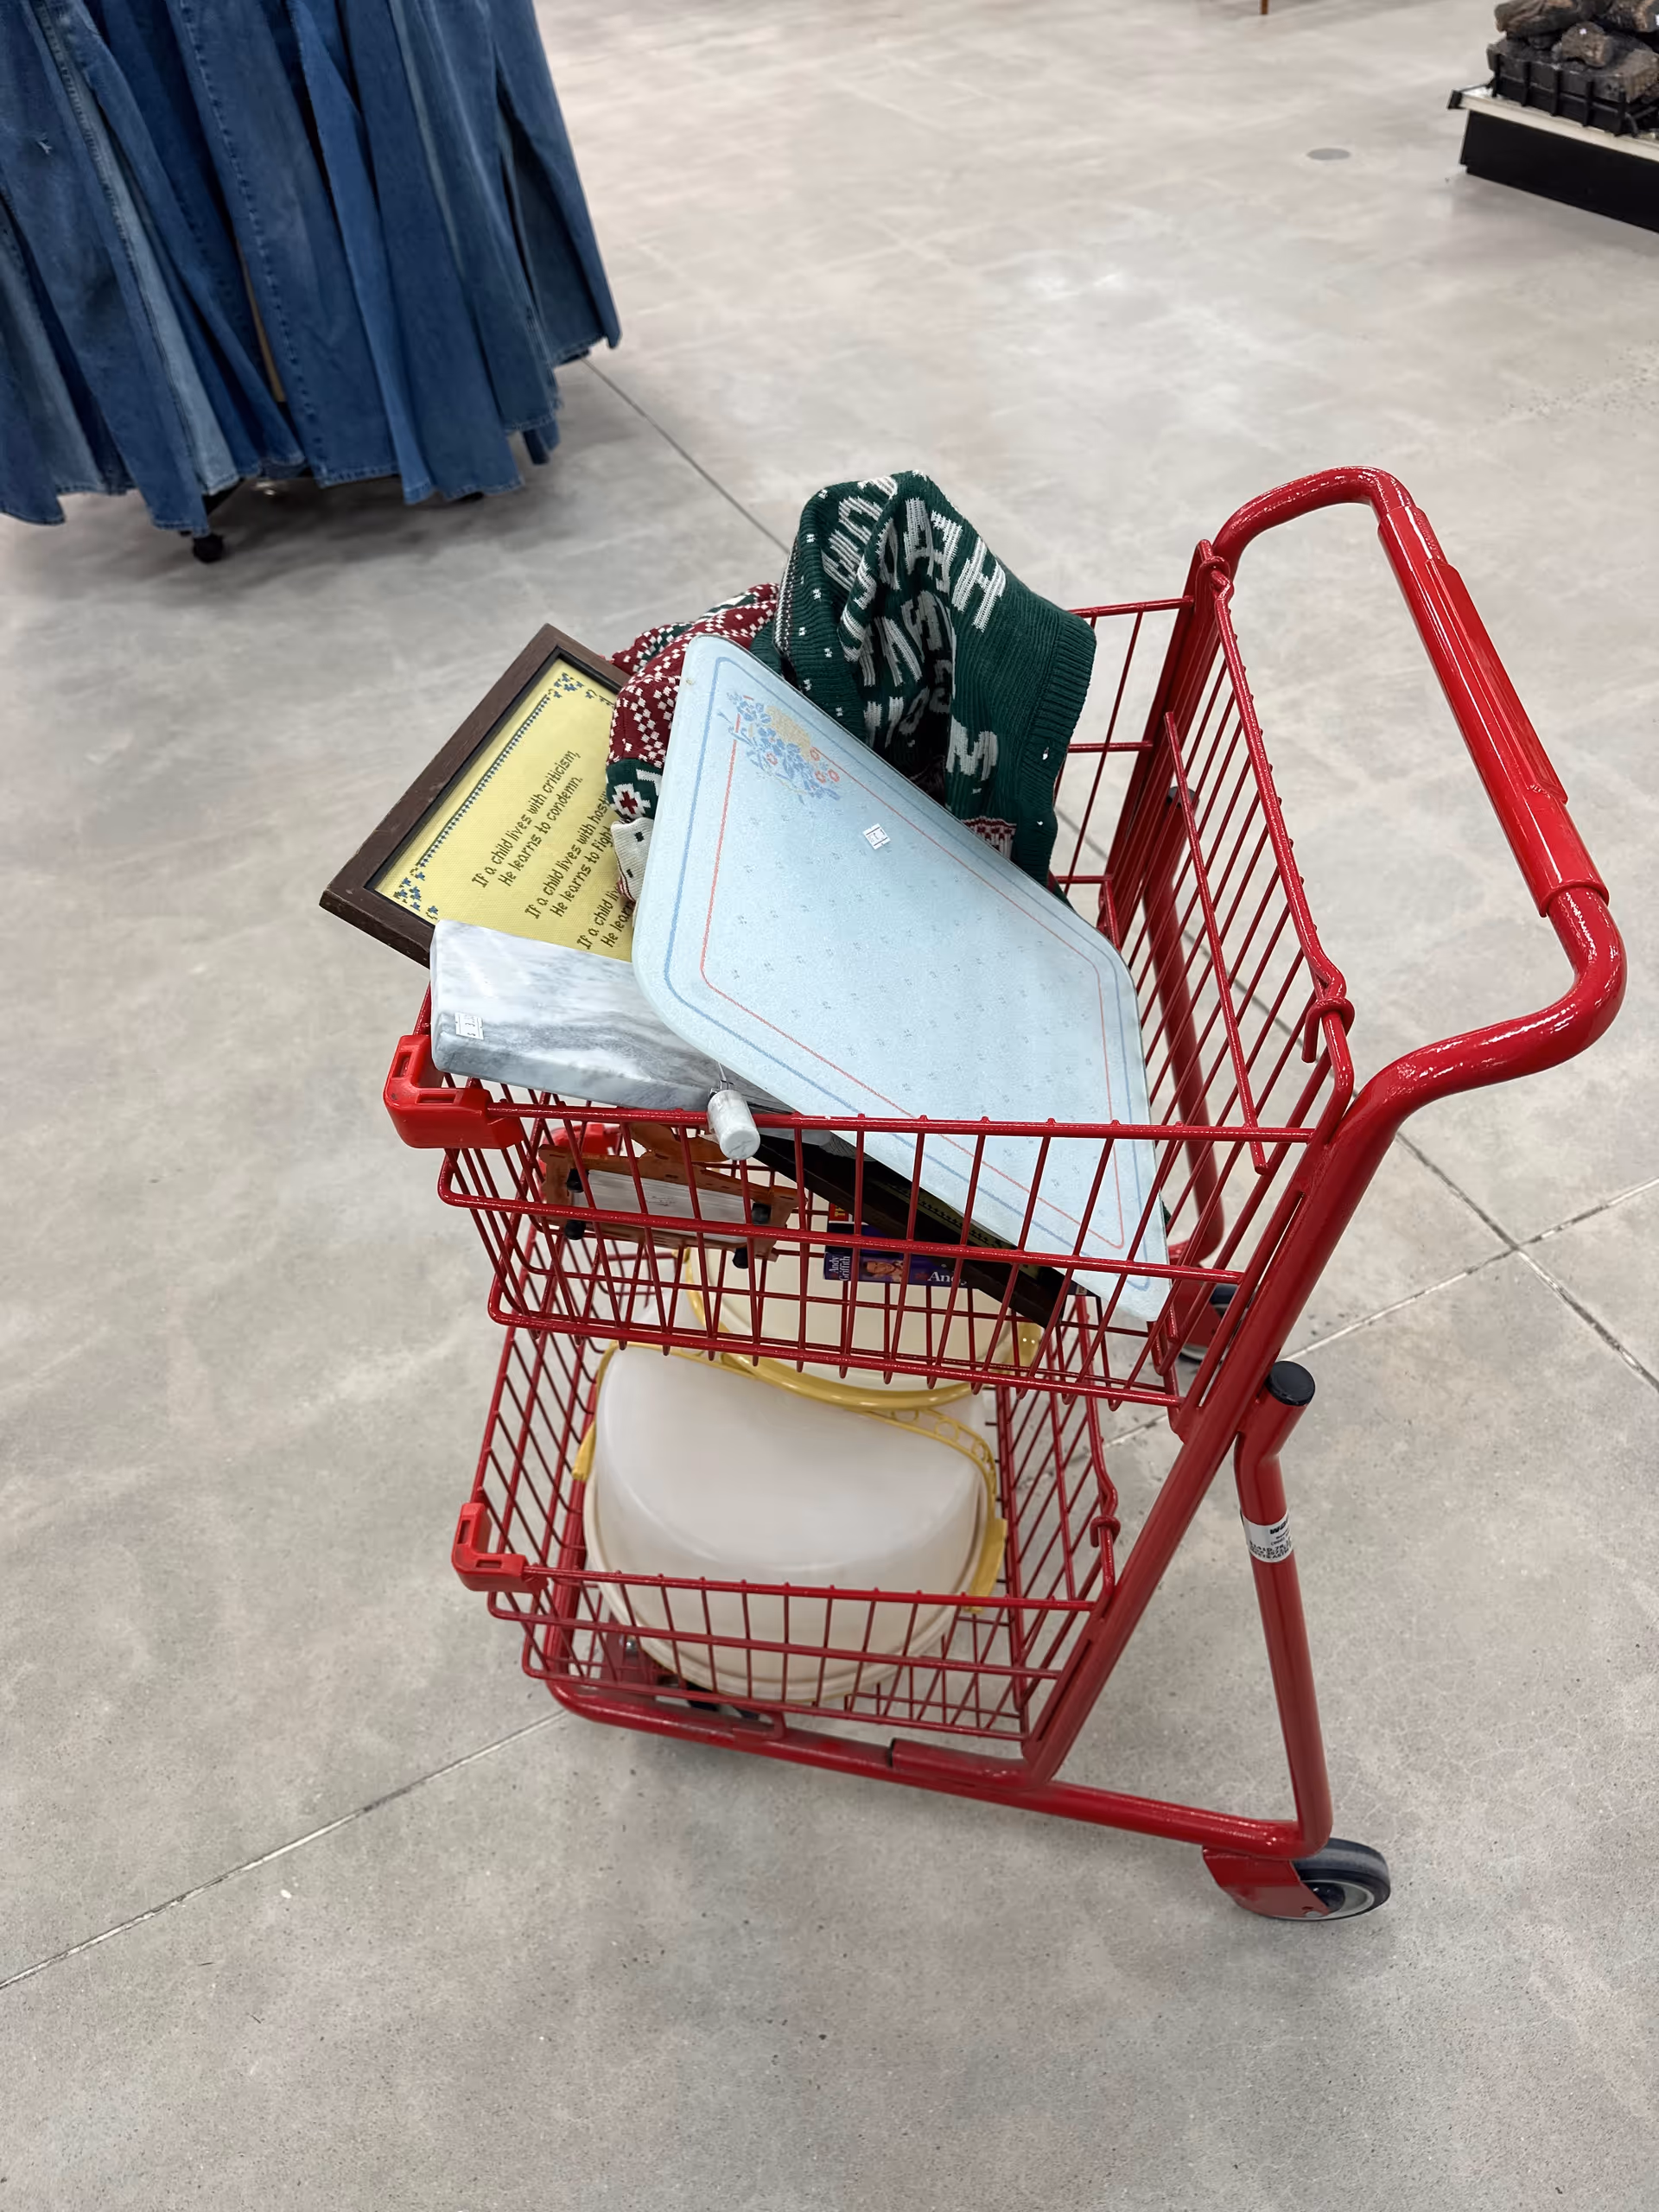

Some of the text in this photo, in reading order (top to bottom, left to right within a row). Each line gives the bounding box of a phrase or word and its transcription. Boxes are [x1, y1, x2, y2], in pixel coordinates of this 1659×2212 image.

[472, 750, 581, 888] If a child lives with criticism,
[498, 777, 583, 887] He learns to condemn.
[524, 904, 542, 919] If
[537, 897, 549, 906] a
[543, 868, 564, 896] child
[556, 843, 582, 873] lives
[576, 823, 597, 845] with
[550, 901, 568, 918] He
[563, 864, 592, 903] learns
[584, 851, 600, 865] to
[576, 886, 620, 950] If a child liv
[600, 905, 634, 948] He lear
[829, 1255, 839, 1274] Andy
[839, 1255, 851, 1281] Griffith
